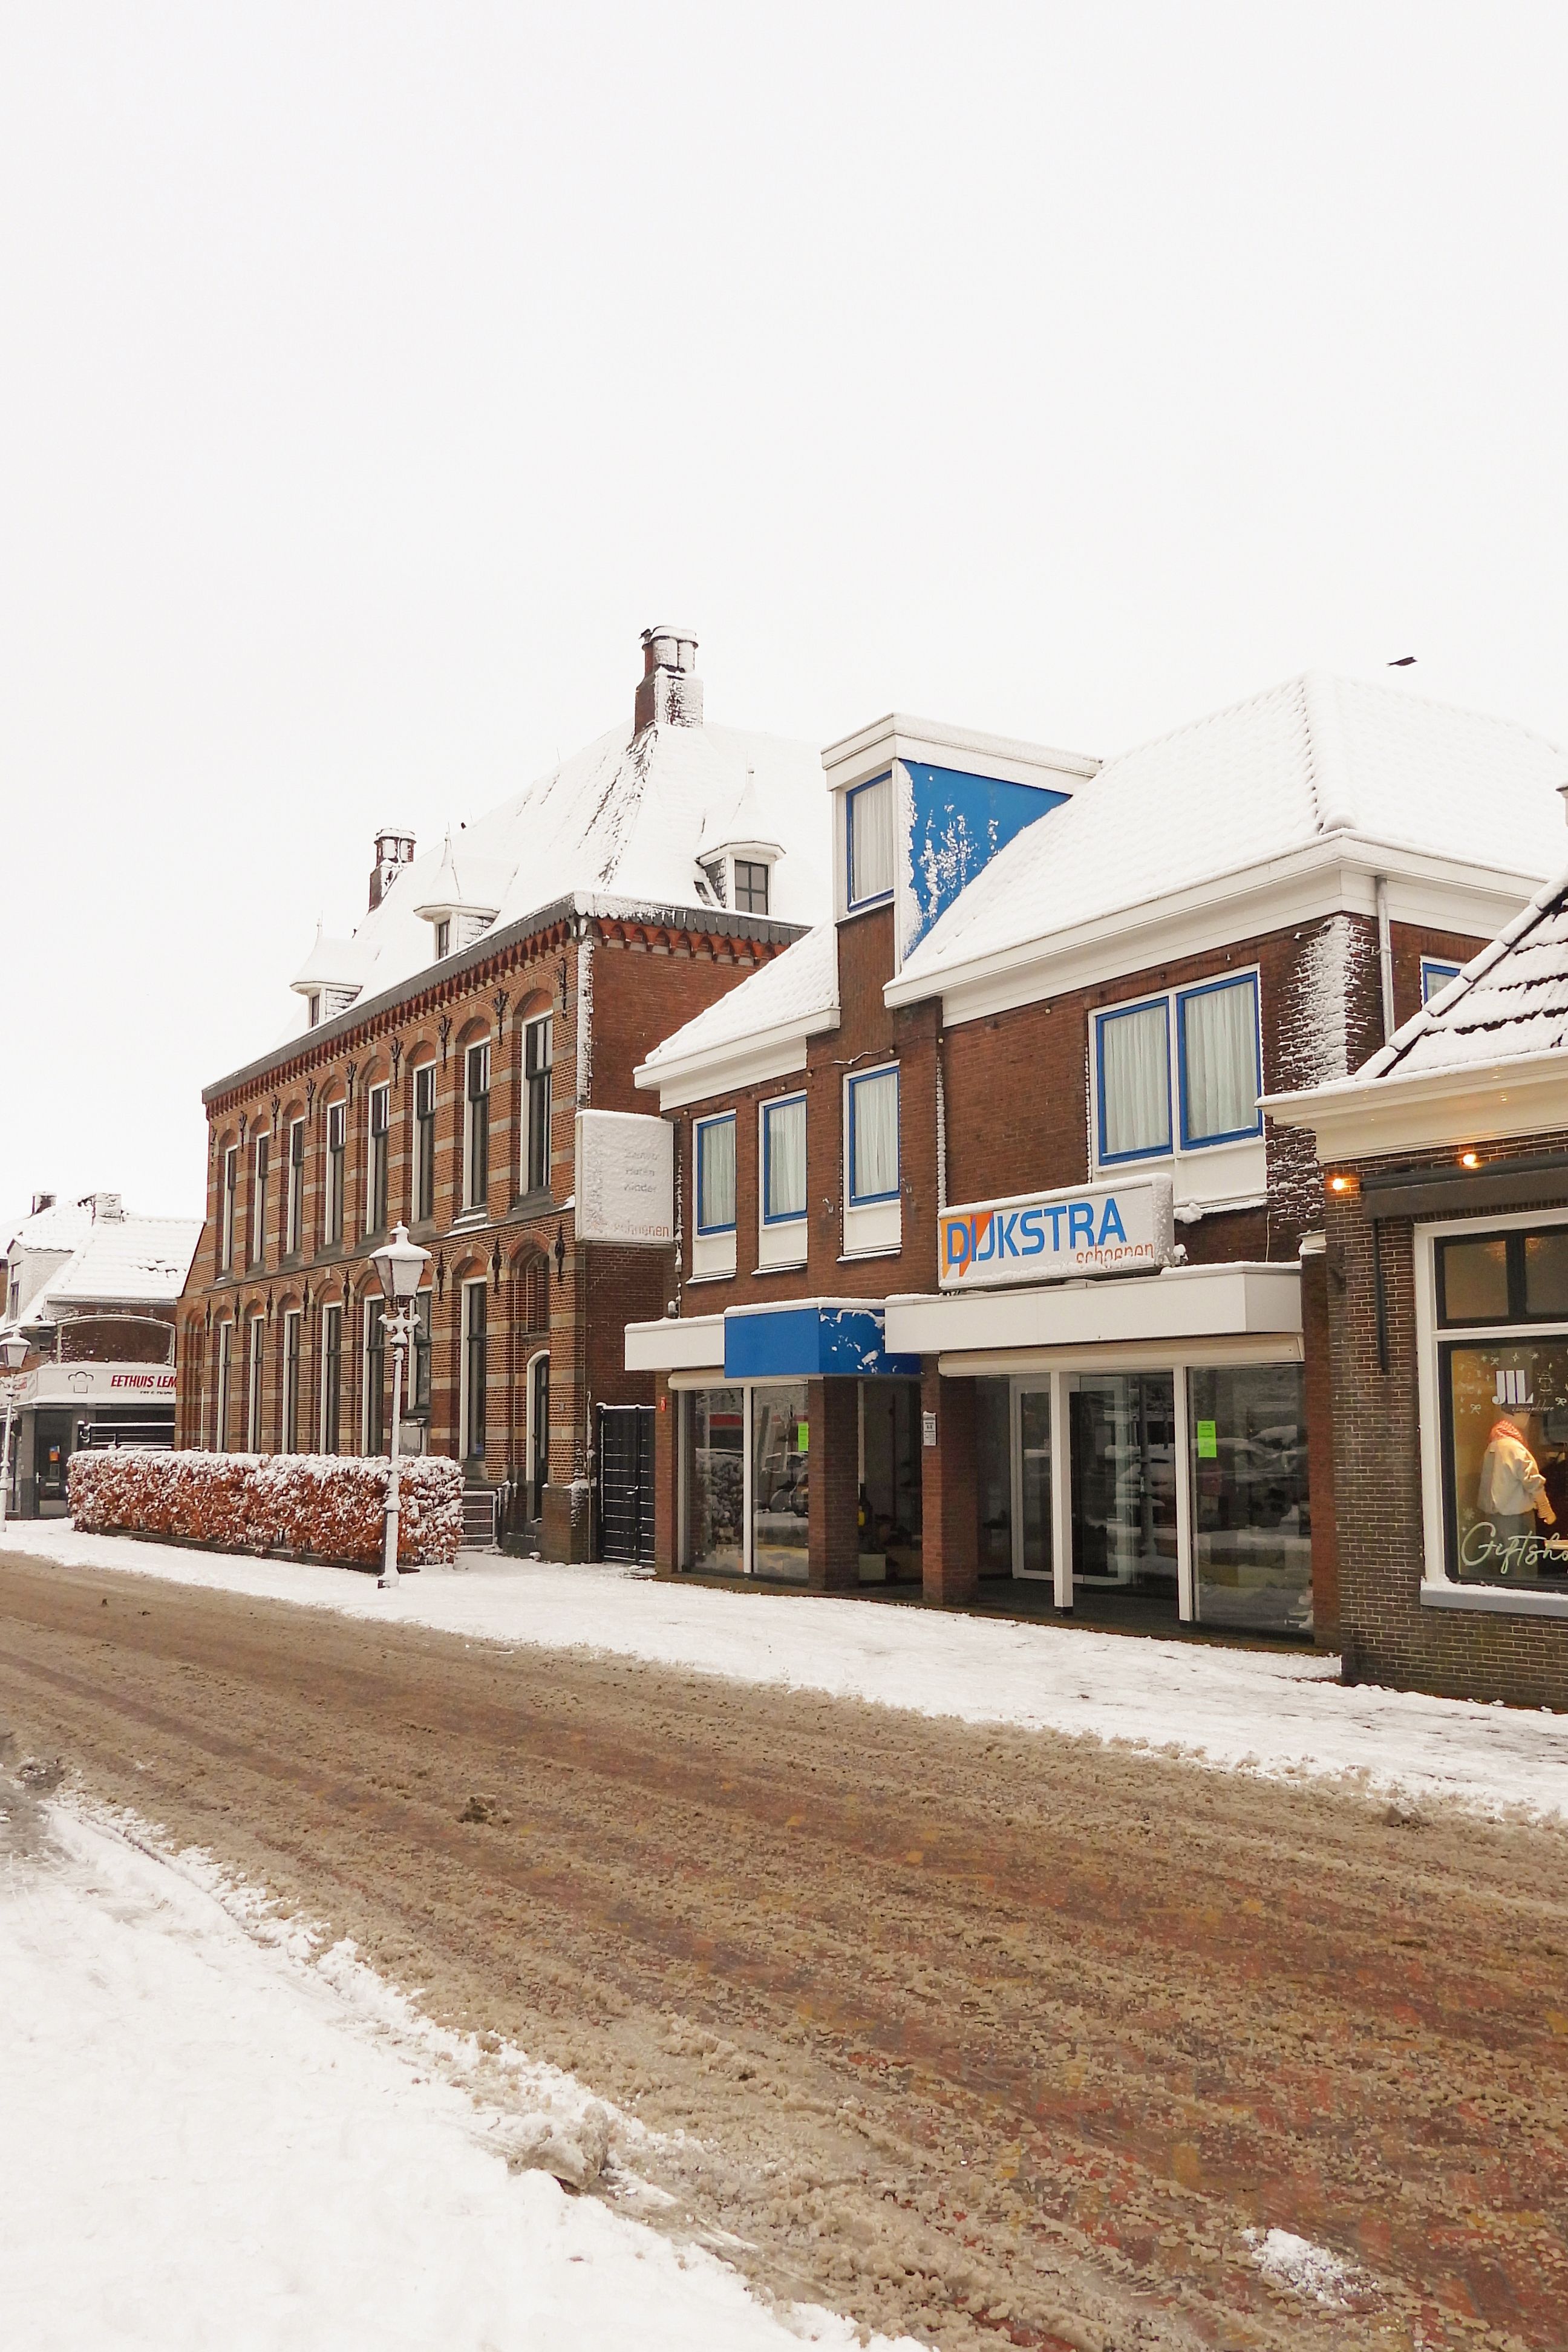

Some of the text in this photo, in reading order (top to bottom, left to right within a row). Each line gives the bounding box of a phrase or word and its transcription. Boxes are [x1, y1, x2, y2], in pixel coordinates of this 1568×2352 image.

[946, 1198, 1127, 1265] DIJKSTRA
[111, 1374, 155, 1388] EETHUIS
[1491, 1370, 1534, 1405] JIL
[1461, 1521, 1568, 1574] Giftsho
